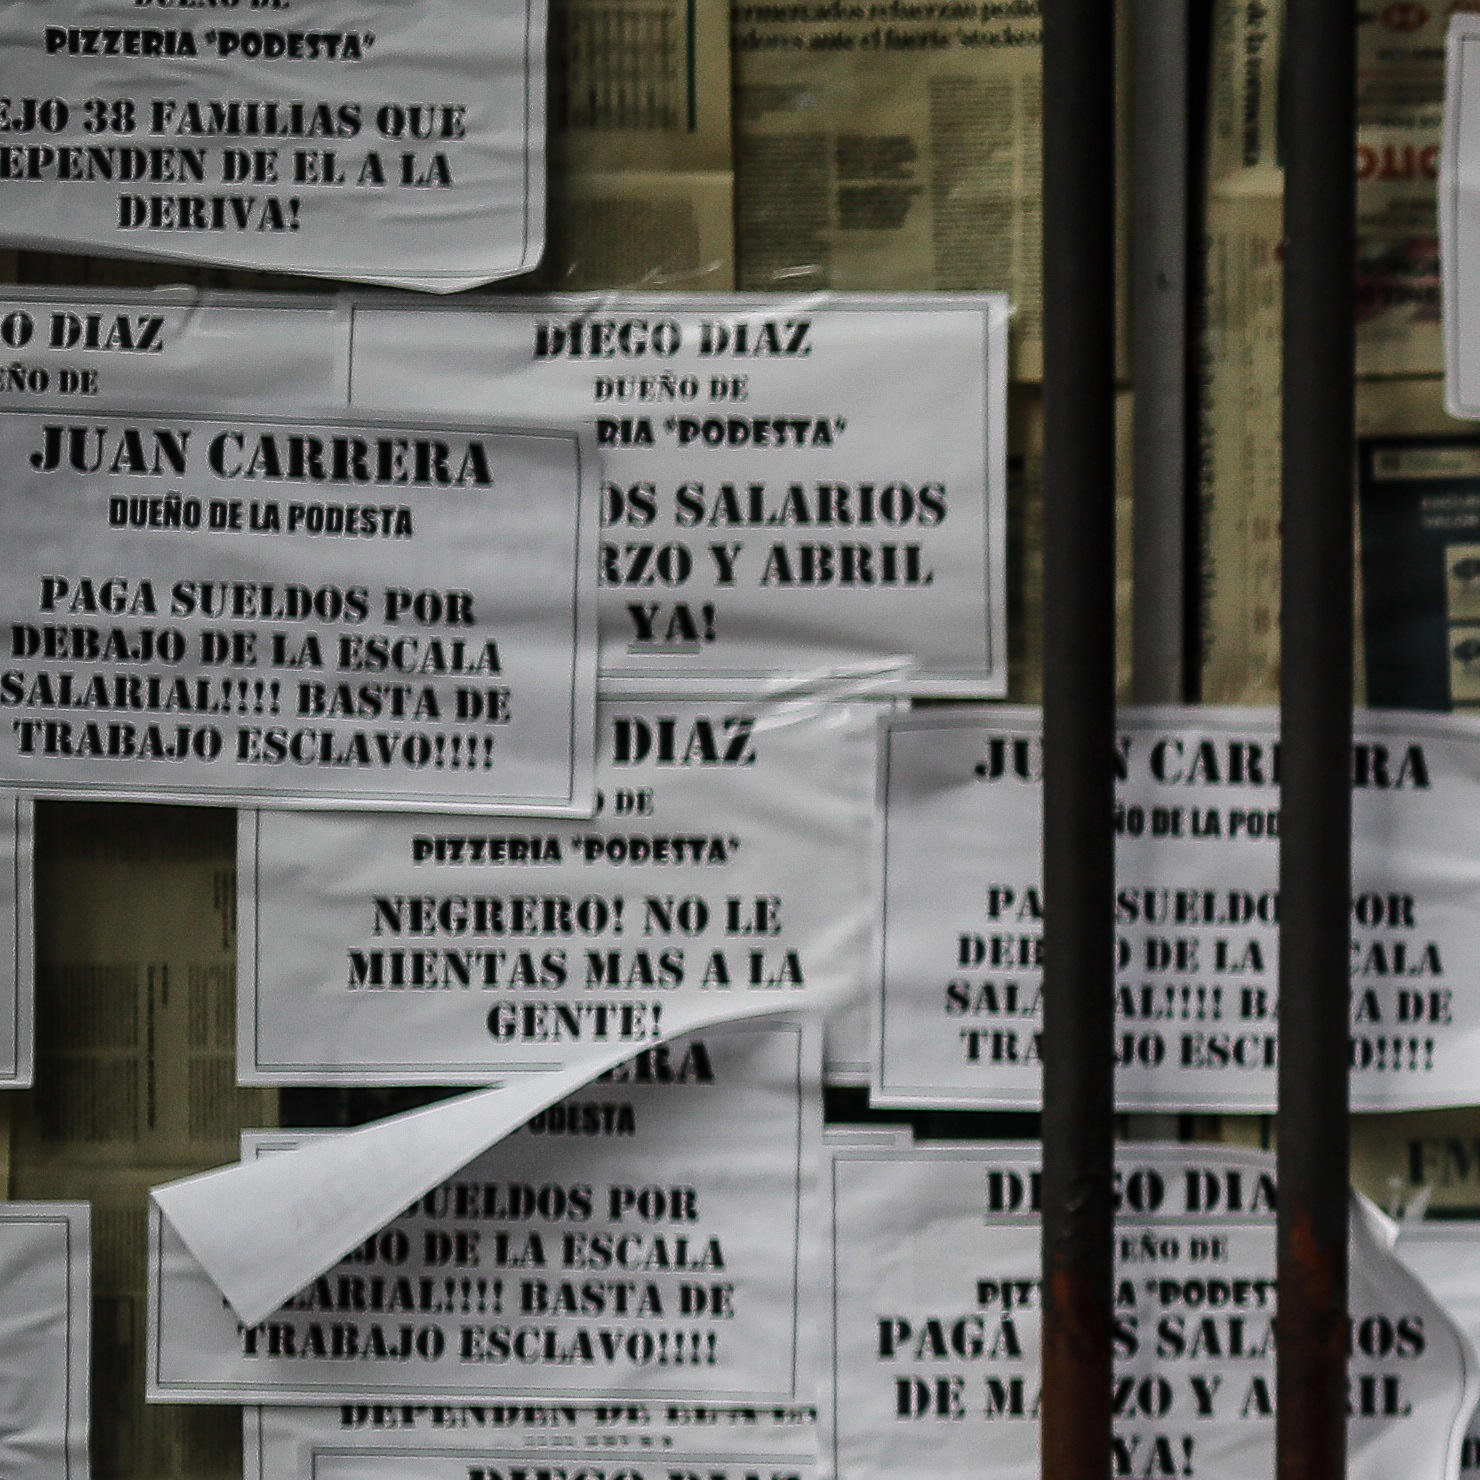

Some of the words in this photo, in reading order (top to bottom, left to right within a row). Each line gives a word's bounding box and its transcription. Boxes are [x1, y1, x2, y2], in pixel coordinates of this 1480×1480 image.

[117, 194, 302, 232] DERIVA!
[530, 318, 682, 362] DIEGO
[698, 320, 813, 357] DIAZ
[593, 374, 701, 401] DUEÑO
[708, 376, 749, 401] DE
[27, 424, 192, 475] JUAN
[207, 431, 494, 487] CARRERA
[107, 494, 204, 531] DUEÑO
[207, 499, 244, 531] DE
[248, 500, 282, 533] LA
[286, 503, 415, 538] PODESTA
[39, 576, 158, 615] PAGA
[170, 580, 371, 622] SUELDOS
[383, 588, 479, 628] POR
[625, 603, 718, 643] YA!
[11, 719, 224, 760] TRABAJO
[236, 726, 495, 770] ESCLAVO!!!!
[371, 895, 626, 936] NEGRERO!
[643, 897, 711, 934] NO
[725, 897, 783, 935] LE
